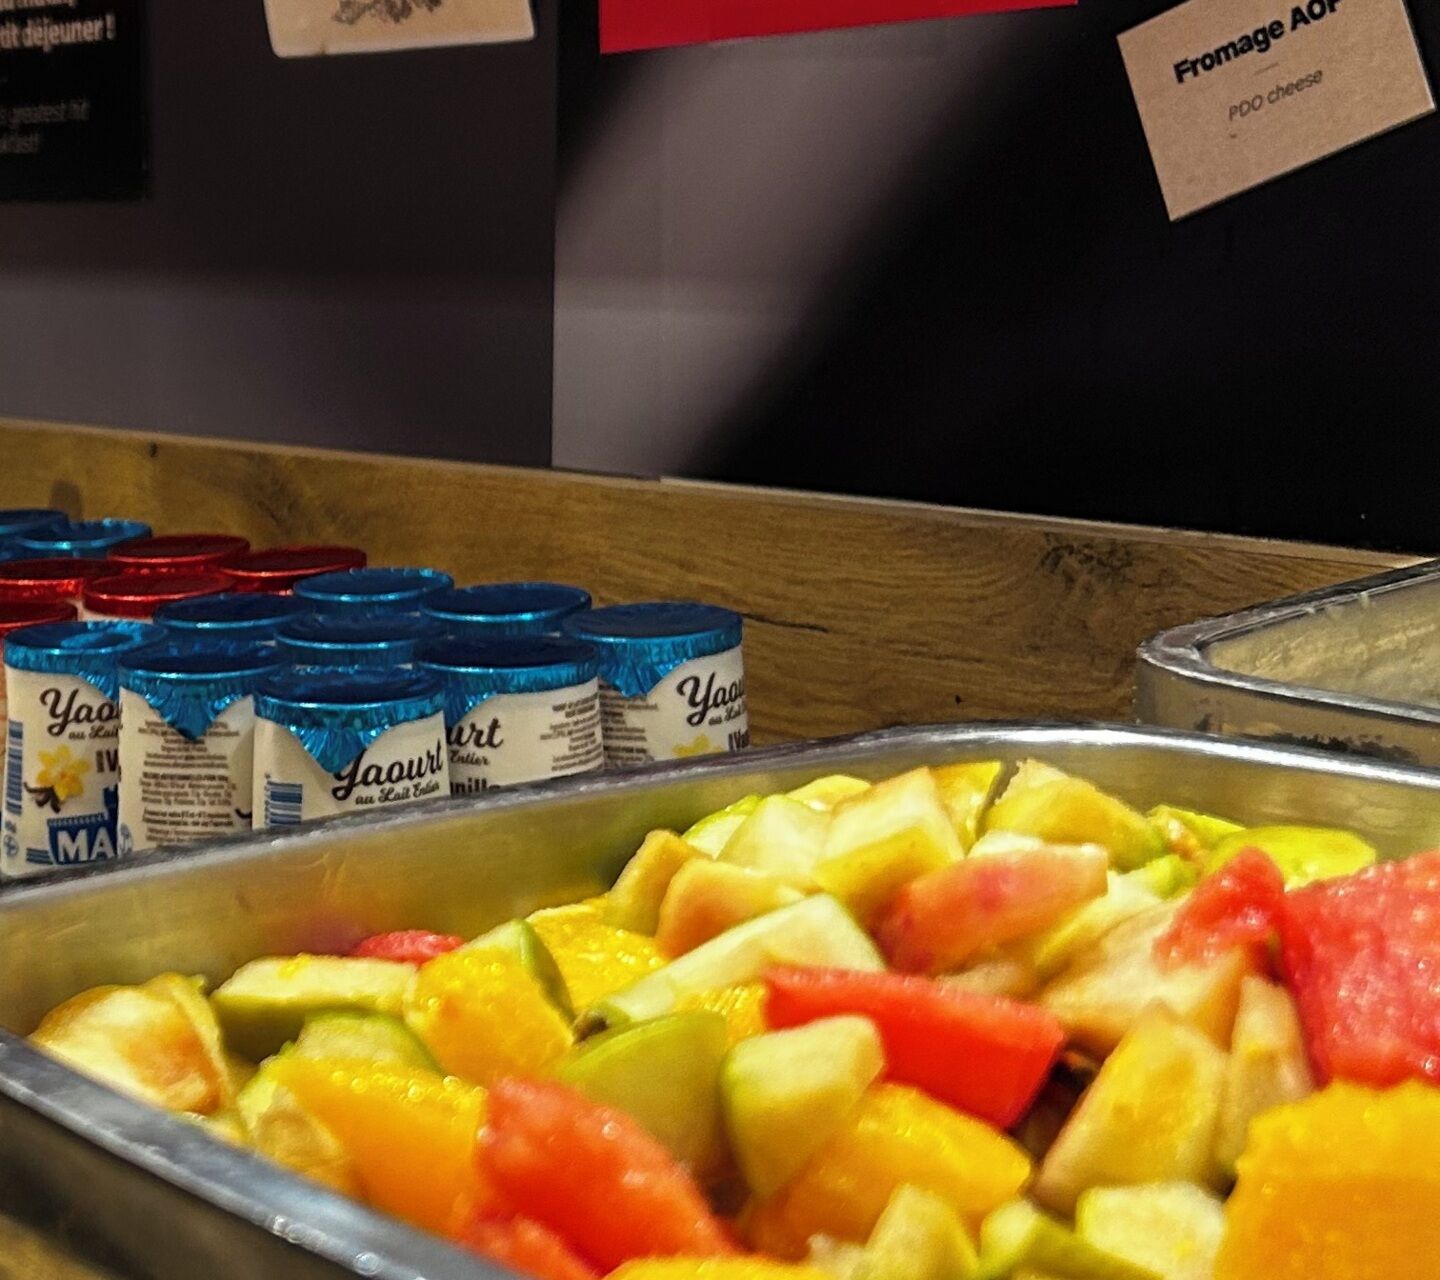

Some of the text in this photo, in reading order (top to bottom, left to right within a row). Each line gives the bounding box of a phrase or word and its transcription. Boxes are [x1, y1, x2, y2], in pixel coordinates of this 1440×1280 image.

[21, 16, 104, 54] déjeuner
[106, 12, 117, 40] !
[1172, 19, 1285, 86] Fromage
[1227, 68, 1324, 122] PDO cheese
[39, 687, 121, 738] Yao
[446, 716, 504, 749] urt
[331, 737, 444, 802] Yaourt
[355, 794, 375, 806] au
[377, 787, 411, 805] Lait
[56, 827, 117, 862] MA
